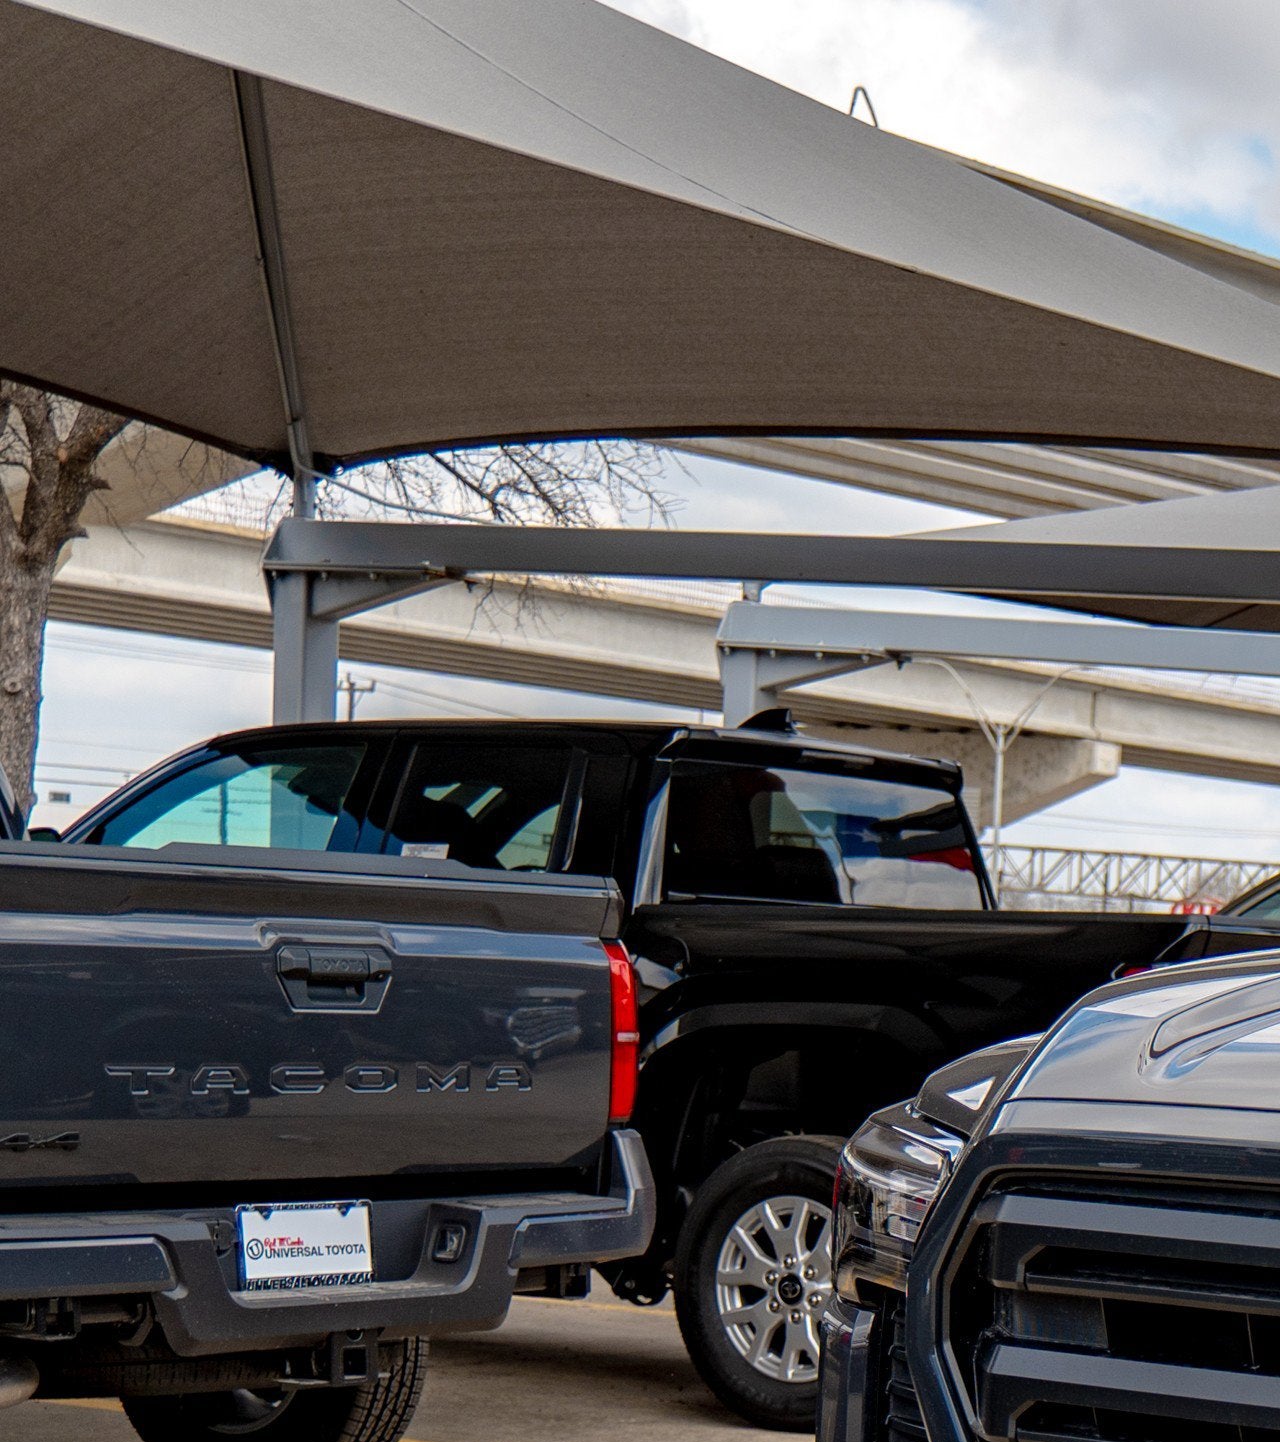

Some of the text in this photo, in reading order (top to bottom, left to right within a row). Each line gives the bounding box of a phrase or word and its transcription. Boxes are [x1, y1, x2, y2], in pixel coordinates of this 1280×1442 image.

[104, 1062, 532, 1096] TACOMA
[264, 1243, 366, 1259] UNIVERSAL TOYOTA
